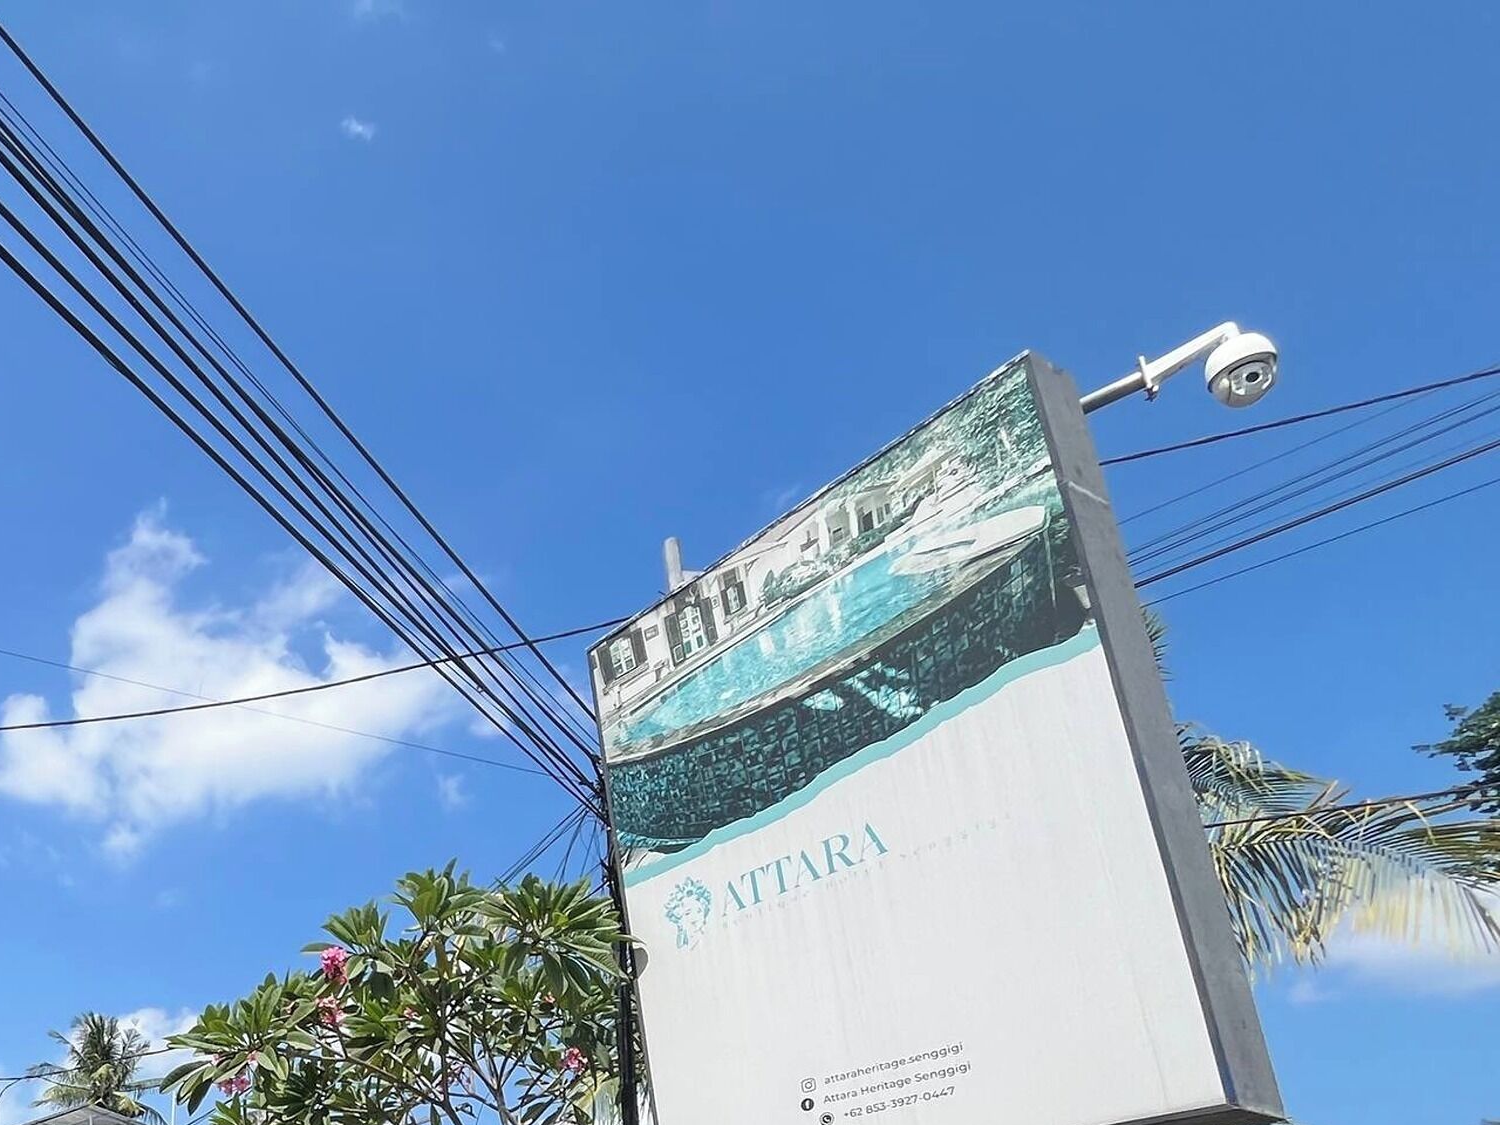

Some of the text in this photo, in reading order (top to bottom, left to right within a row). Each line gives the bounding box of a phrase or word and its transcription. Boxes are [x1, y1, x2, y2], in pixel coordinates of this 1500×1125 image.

[721, 822, 889, 918] ATTARA
[823, 1041, 964, 1085] attaraheritage.senggigi
[823, 1061, 972, 1104] Attara Heritage Senggigi
[844, 1086, 956, 1118] +62 853-3927-0447
